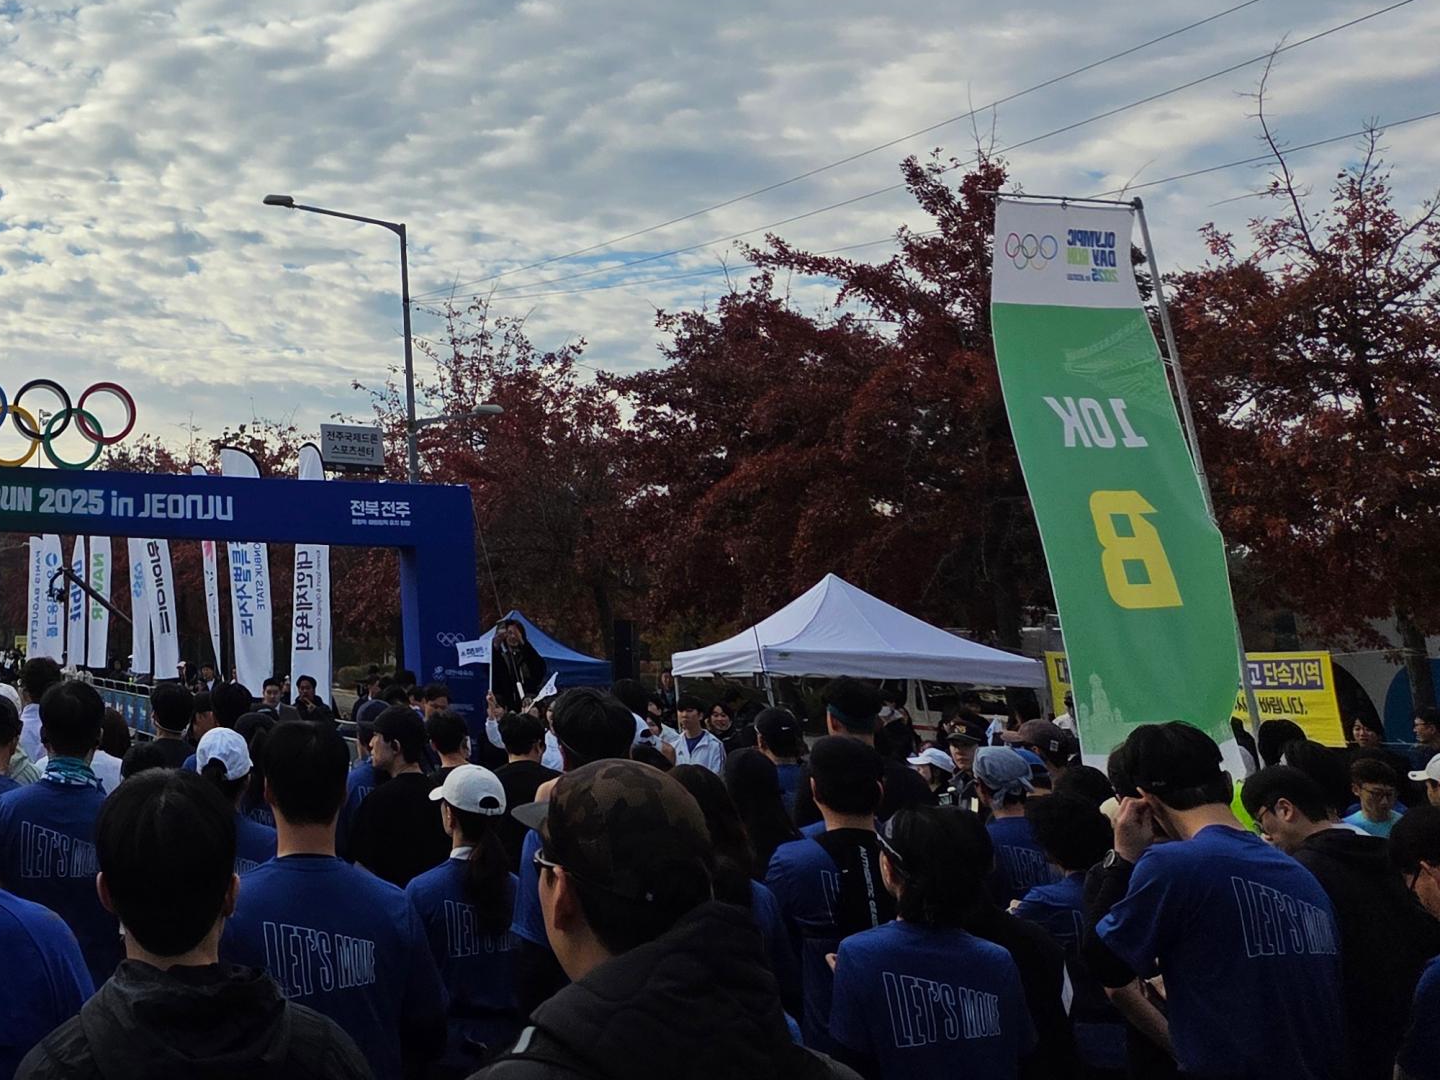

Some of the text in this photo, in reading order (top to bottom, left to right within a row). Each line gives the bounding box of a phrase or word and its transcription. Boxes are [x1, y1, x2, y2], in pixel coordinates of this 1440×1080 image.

[39, 488, 104, 515] 2025
[111, 490, 134, 517] in
[138, 493, 234, 521] JEONJU
[350, 500, 411, 518] 전북 전주
[1263, 662, 1320, 686] 단속지역
[20, 820, 70, 878] LET'S
[1231, 876, 1305, 958] LET'S
[263, 921, 335, 999] LET'S
[882, 971, 959, 1048] LET'S
